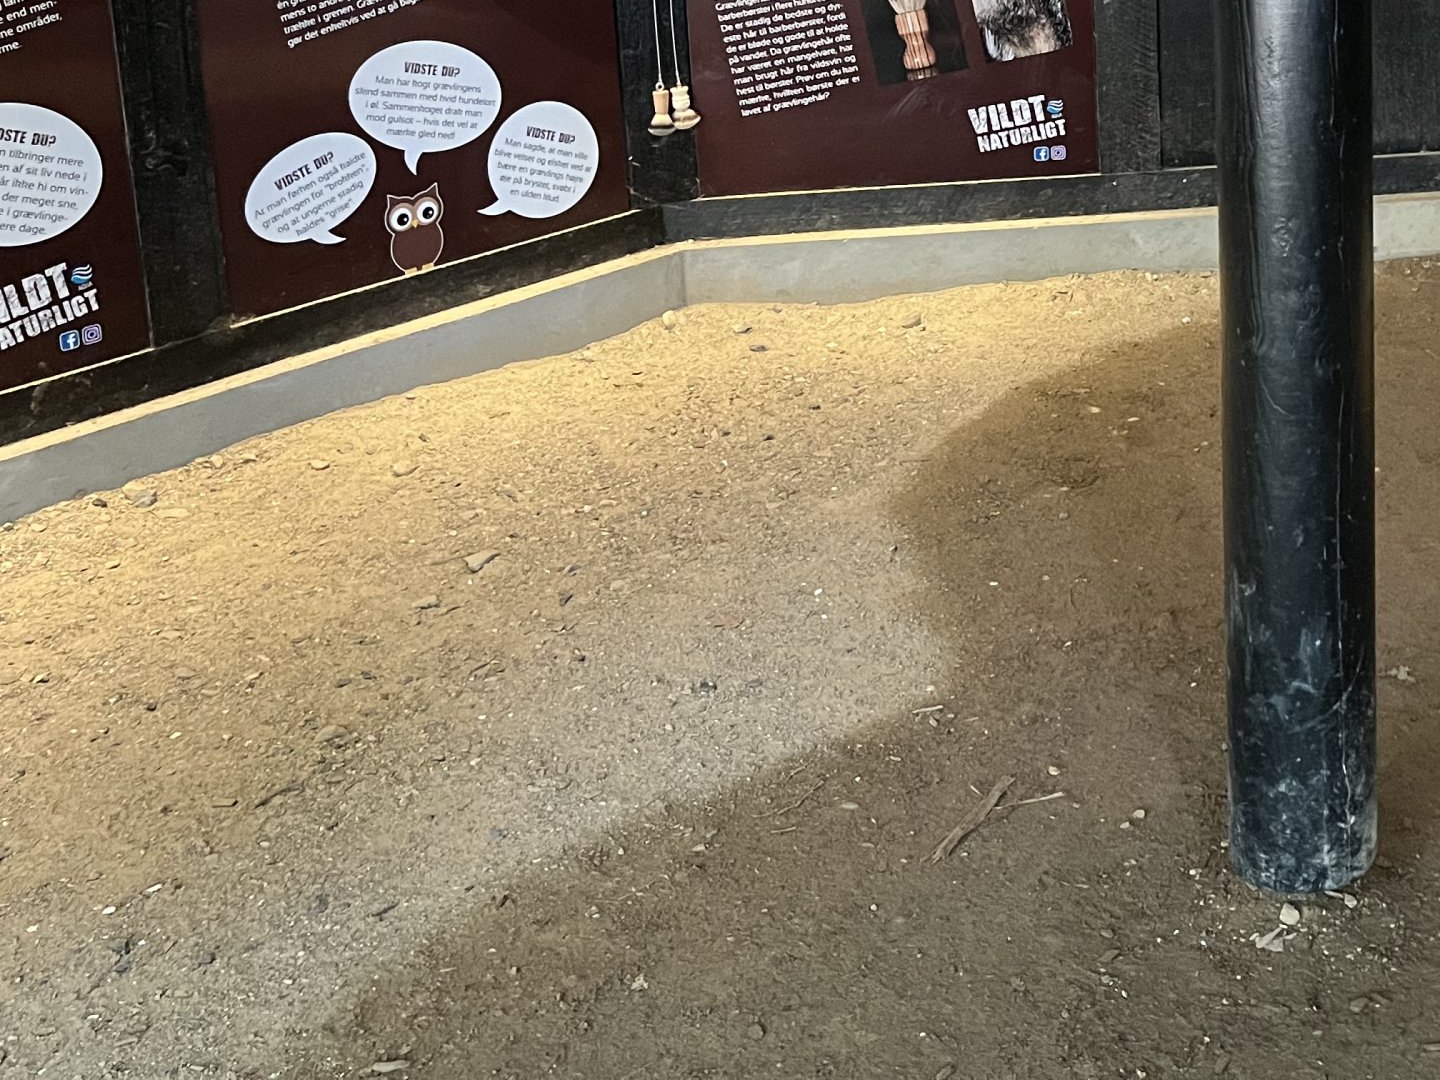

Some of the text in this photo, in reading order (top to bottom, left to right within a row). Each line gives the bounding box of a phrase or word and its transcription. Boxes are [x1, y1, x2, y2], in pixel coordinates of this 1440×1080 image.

[6, 7, 27, 21] end
[29, 1, 57, 13] men-
[16, 13, 62, 32] områder,
[404, 62, 460, 77] VIDSTE DU?
[968, 94, 1045, 134] VILDT
[31, 132, 56, 146] DU?
[526, 126, 575, 144] VIDSTE DU?
[977, 119, 1066, 153] NATURLIGT
[9, 150, 55, 163] tilbringer
[57, 157, 84, 167] mere
[12, 164, 24, 172] af
[26, 167, 38, 175] sit
[41, 167, 52, 177] liv
[54, 171, 80, 181] nede
[274, 151, 333, 190] VIDSTE DU?
[12, 179, 34, 189] ikke
[50, 185, 66, 193] om
[2, 192, 19, 202] der
[21, 196, 55, 207] meget
[0, 262, 69, 324] ILDT
[0, 288, 99, 350] ATURLIGT
